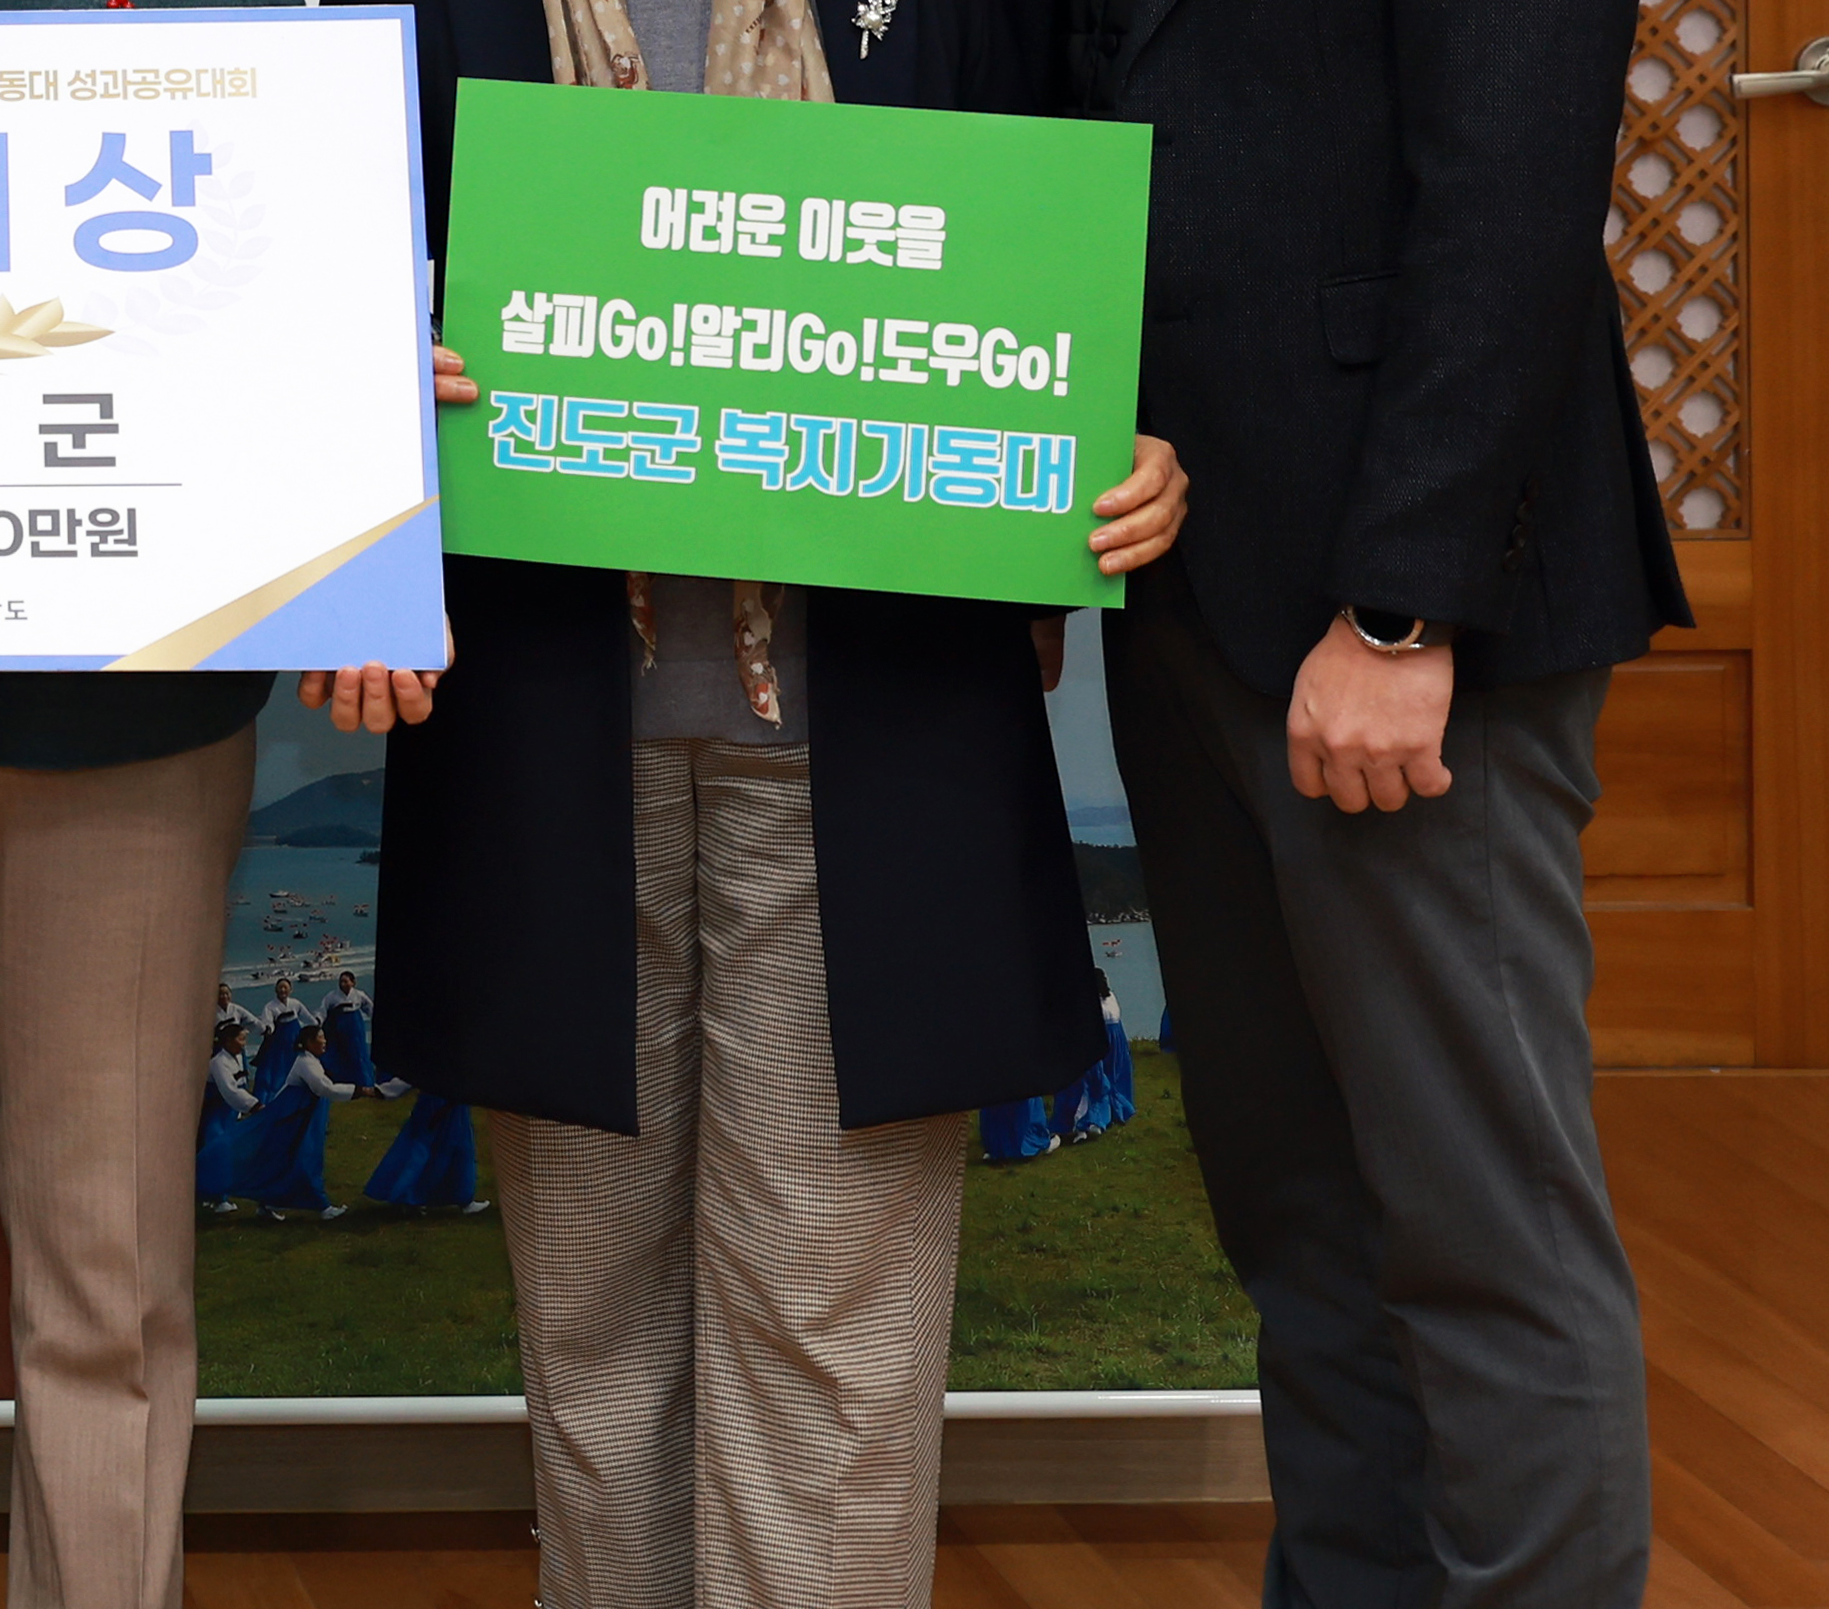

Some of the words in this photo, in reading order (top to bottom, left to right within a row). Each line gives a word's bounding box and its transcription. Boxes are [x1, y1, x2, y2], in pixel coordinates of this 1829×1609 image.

[67, 66, 258, 102] 성과공유대회
[639, 185, 786, 258] 어려운
[798, 197, 947, 270] 이웃을
[488, 390, 701, 484] 진도군
[715, 409, 1076, 515] 복지기동대
